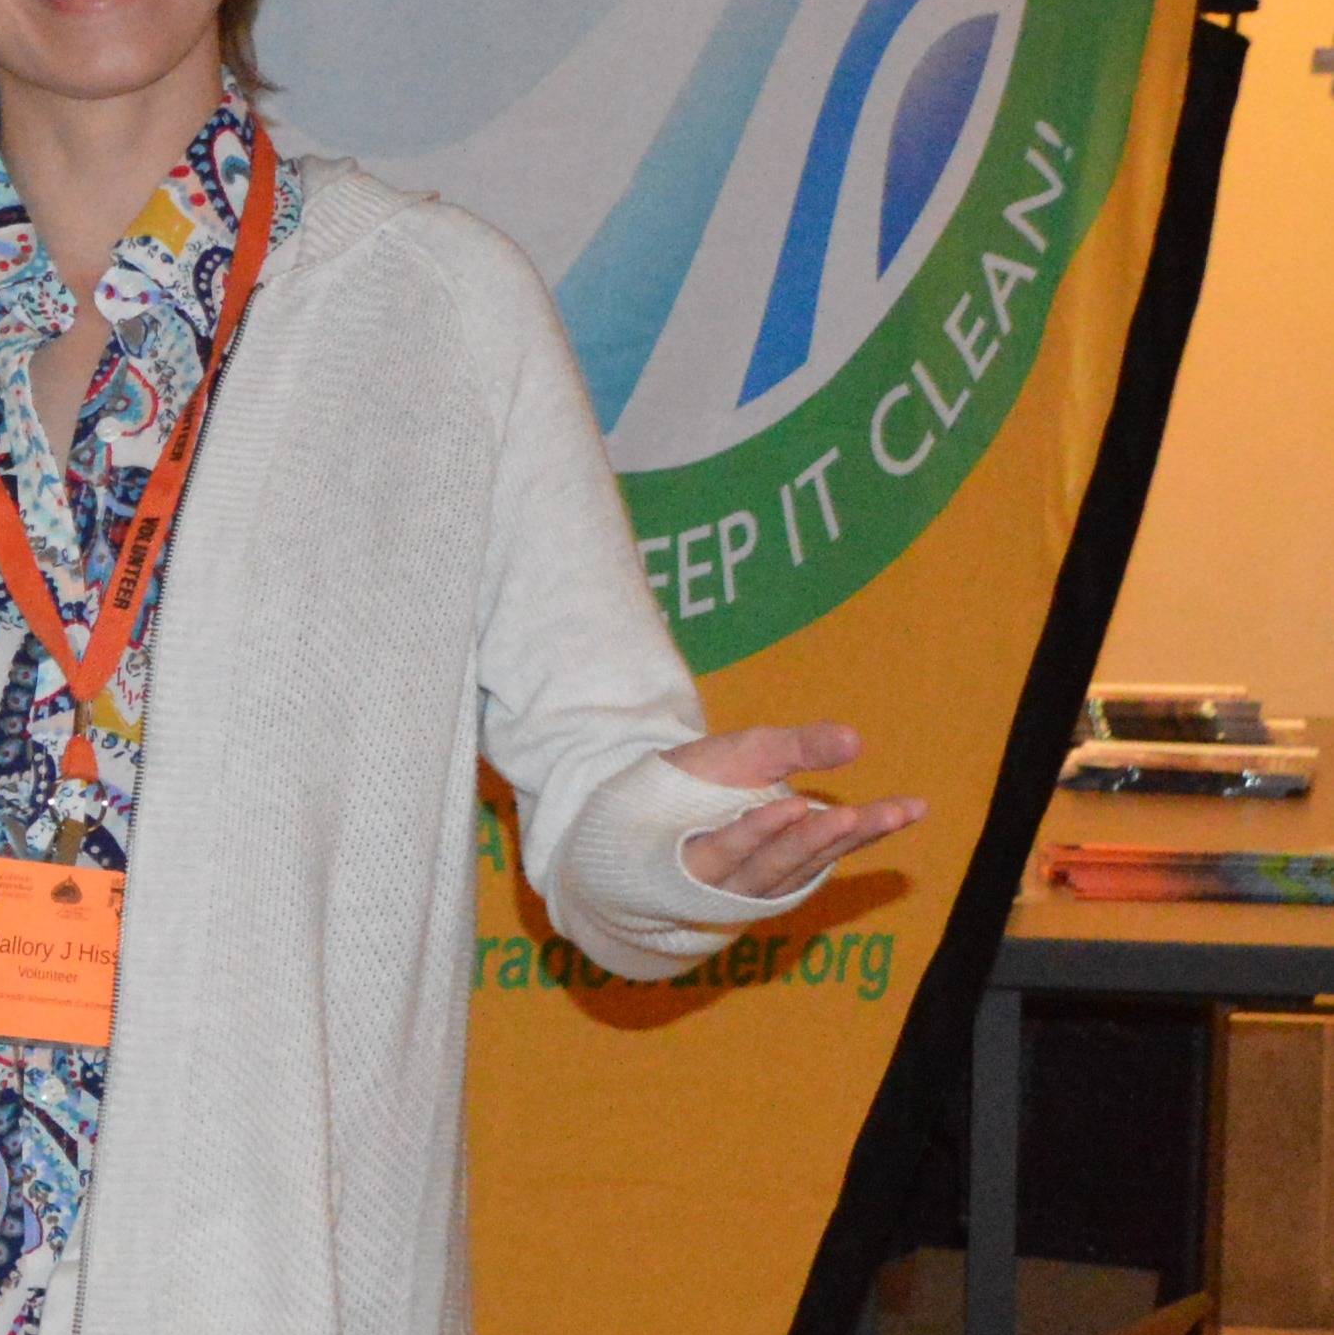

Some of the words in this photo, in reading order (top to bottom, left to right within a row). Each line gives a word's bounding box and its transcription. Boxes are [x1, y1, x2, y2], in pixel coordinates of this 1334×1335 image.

[637, 509, 758, 623] EEP
[779, 447, 841, 567] IT
[870, 120, 1073, 477] CLEAN!
[114, 516, 162, 612] VOLUNTEER
[18, 965, 78, 984] Volunteer
[60, 941, 72, 960] J
